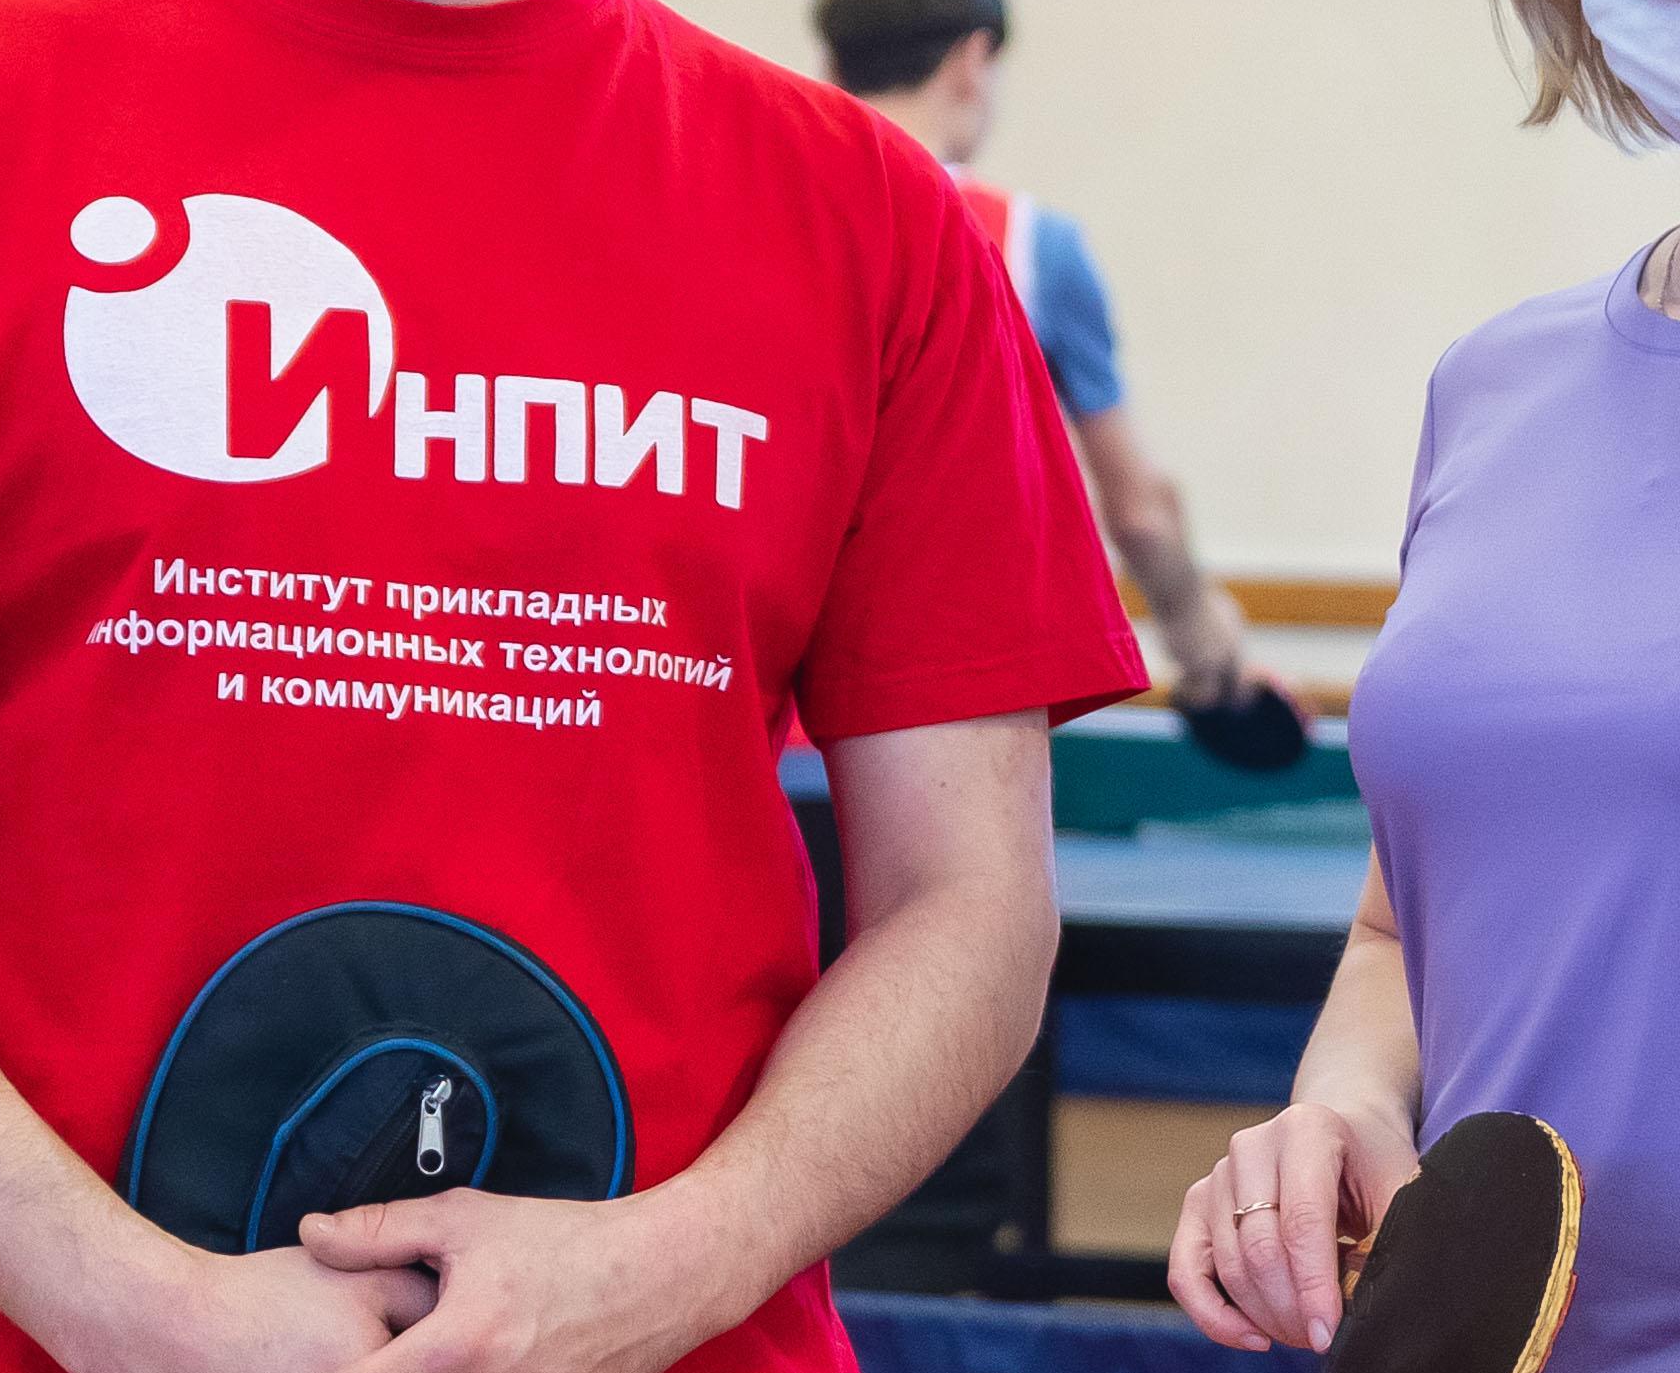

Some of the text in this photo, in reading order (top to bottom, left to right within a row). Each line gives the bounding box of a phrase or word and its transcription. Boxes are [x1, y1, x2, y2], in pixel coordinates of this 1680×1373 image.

[153, 557, 668, 627] Институт прикладных
[498, 641, 733, 692] технологий
[216, 672, 602, 731] и коммуникаций
